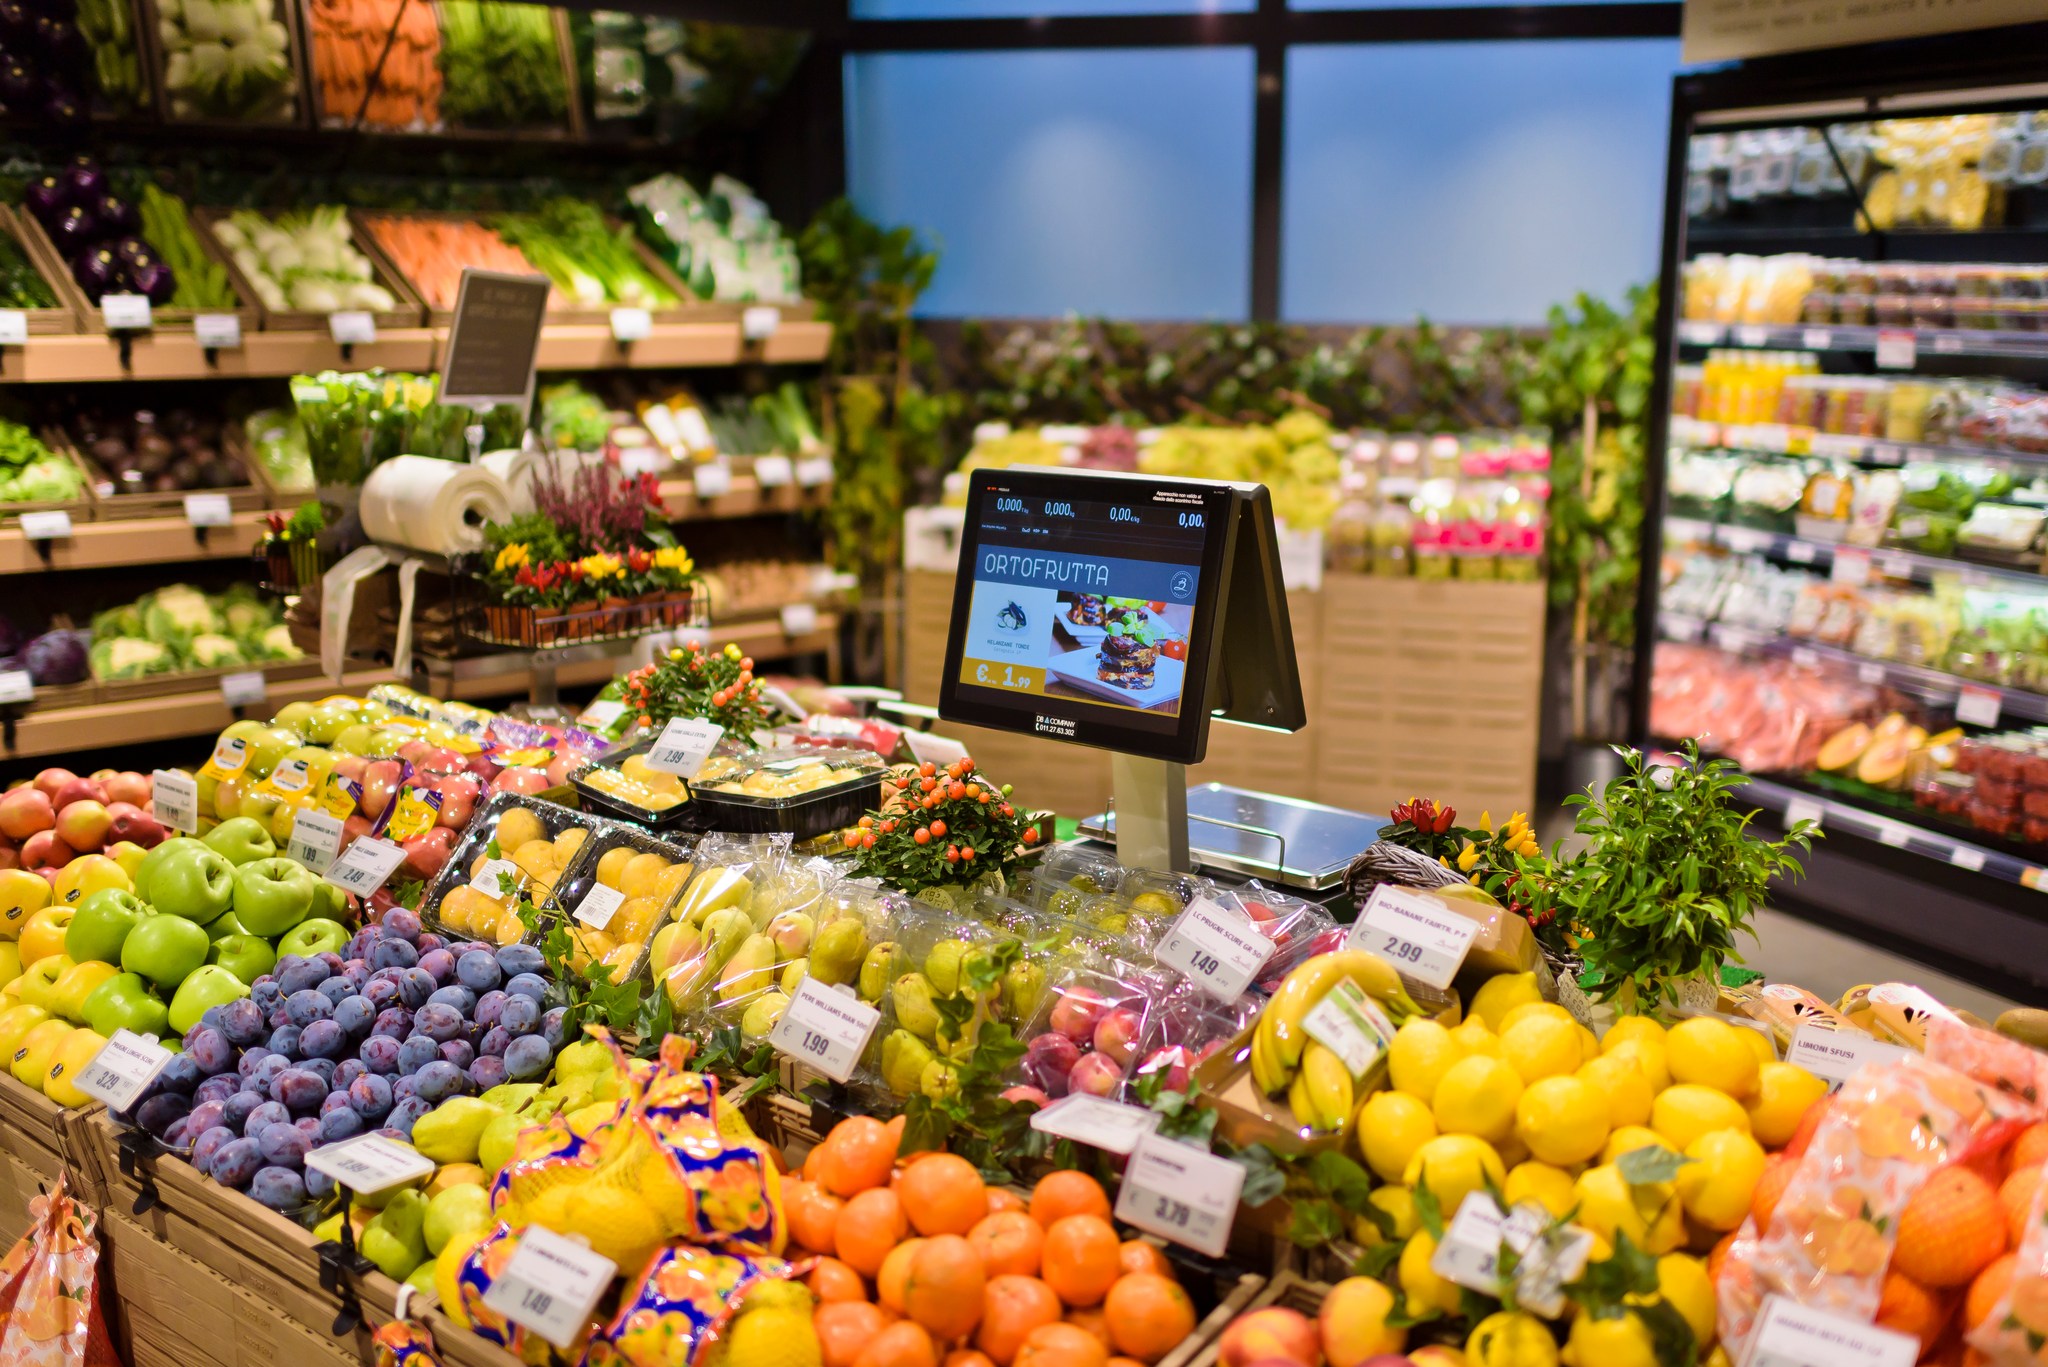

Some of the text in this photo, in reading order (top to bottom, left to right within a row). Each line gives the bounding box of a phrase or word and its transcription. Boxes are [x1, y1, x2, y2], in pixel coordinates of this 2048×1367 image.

[997, 498, 1022, 512] 0,000
[1045, 501, 1070, 516] 0,000
[1110, 506, 1131, 522] 0,00
[1179, 512, 1202, 529] 0,00
[984, 553, 1109, 586] ORTOFRUTTA
[1002, 666, 1031, 688] 1.99
[1039, 724, 1075, 736] 011.27.63.302
[1049, 717, 1076, 728] COMPANY
[663, 750, 685, 764] 2,99
[302, 846, 317, 863] 1,89
[343, 868, 365, 883] 2,49
[1378, 900, 1424, 922] BIO-BANANE
[1200, 916, 1224, 934] PRUGNE
[1223, 931, 1244, 948] SCURE
[1242, 943, 1254, 954] GR
[1383, 937, 1423, 963] 2,99
[1190, 950, 1219, 976] 1,49
[801, 992, 814, 1004] PERE
[815, 999, 842, 1017] WILLIAMS
[112, 1041, 156, 1066] PRUGNE LUNGHE SCURE
[802, 1031, 829, 1056] 1,99
[1798, 1039, 1829, 1053] LIMONI
[1829, 1047, 1855, 1059] SFUSI
[95, 1071, 120, 1091] 3,29
[1155, 1196, 1190, 1227] 3,79
[521, 1288, 552, 1316] 1,49
